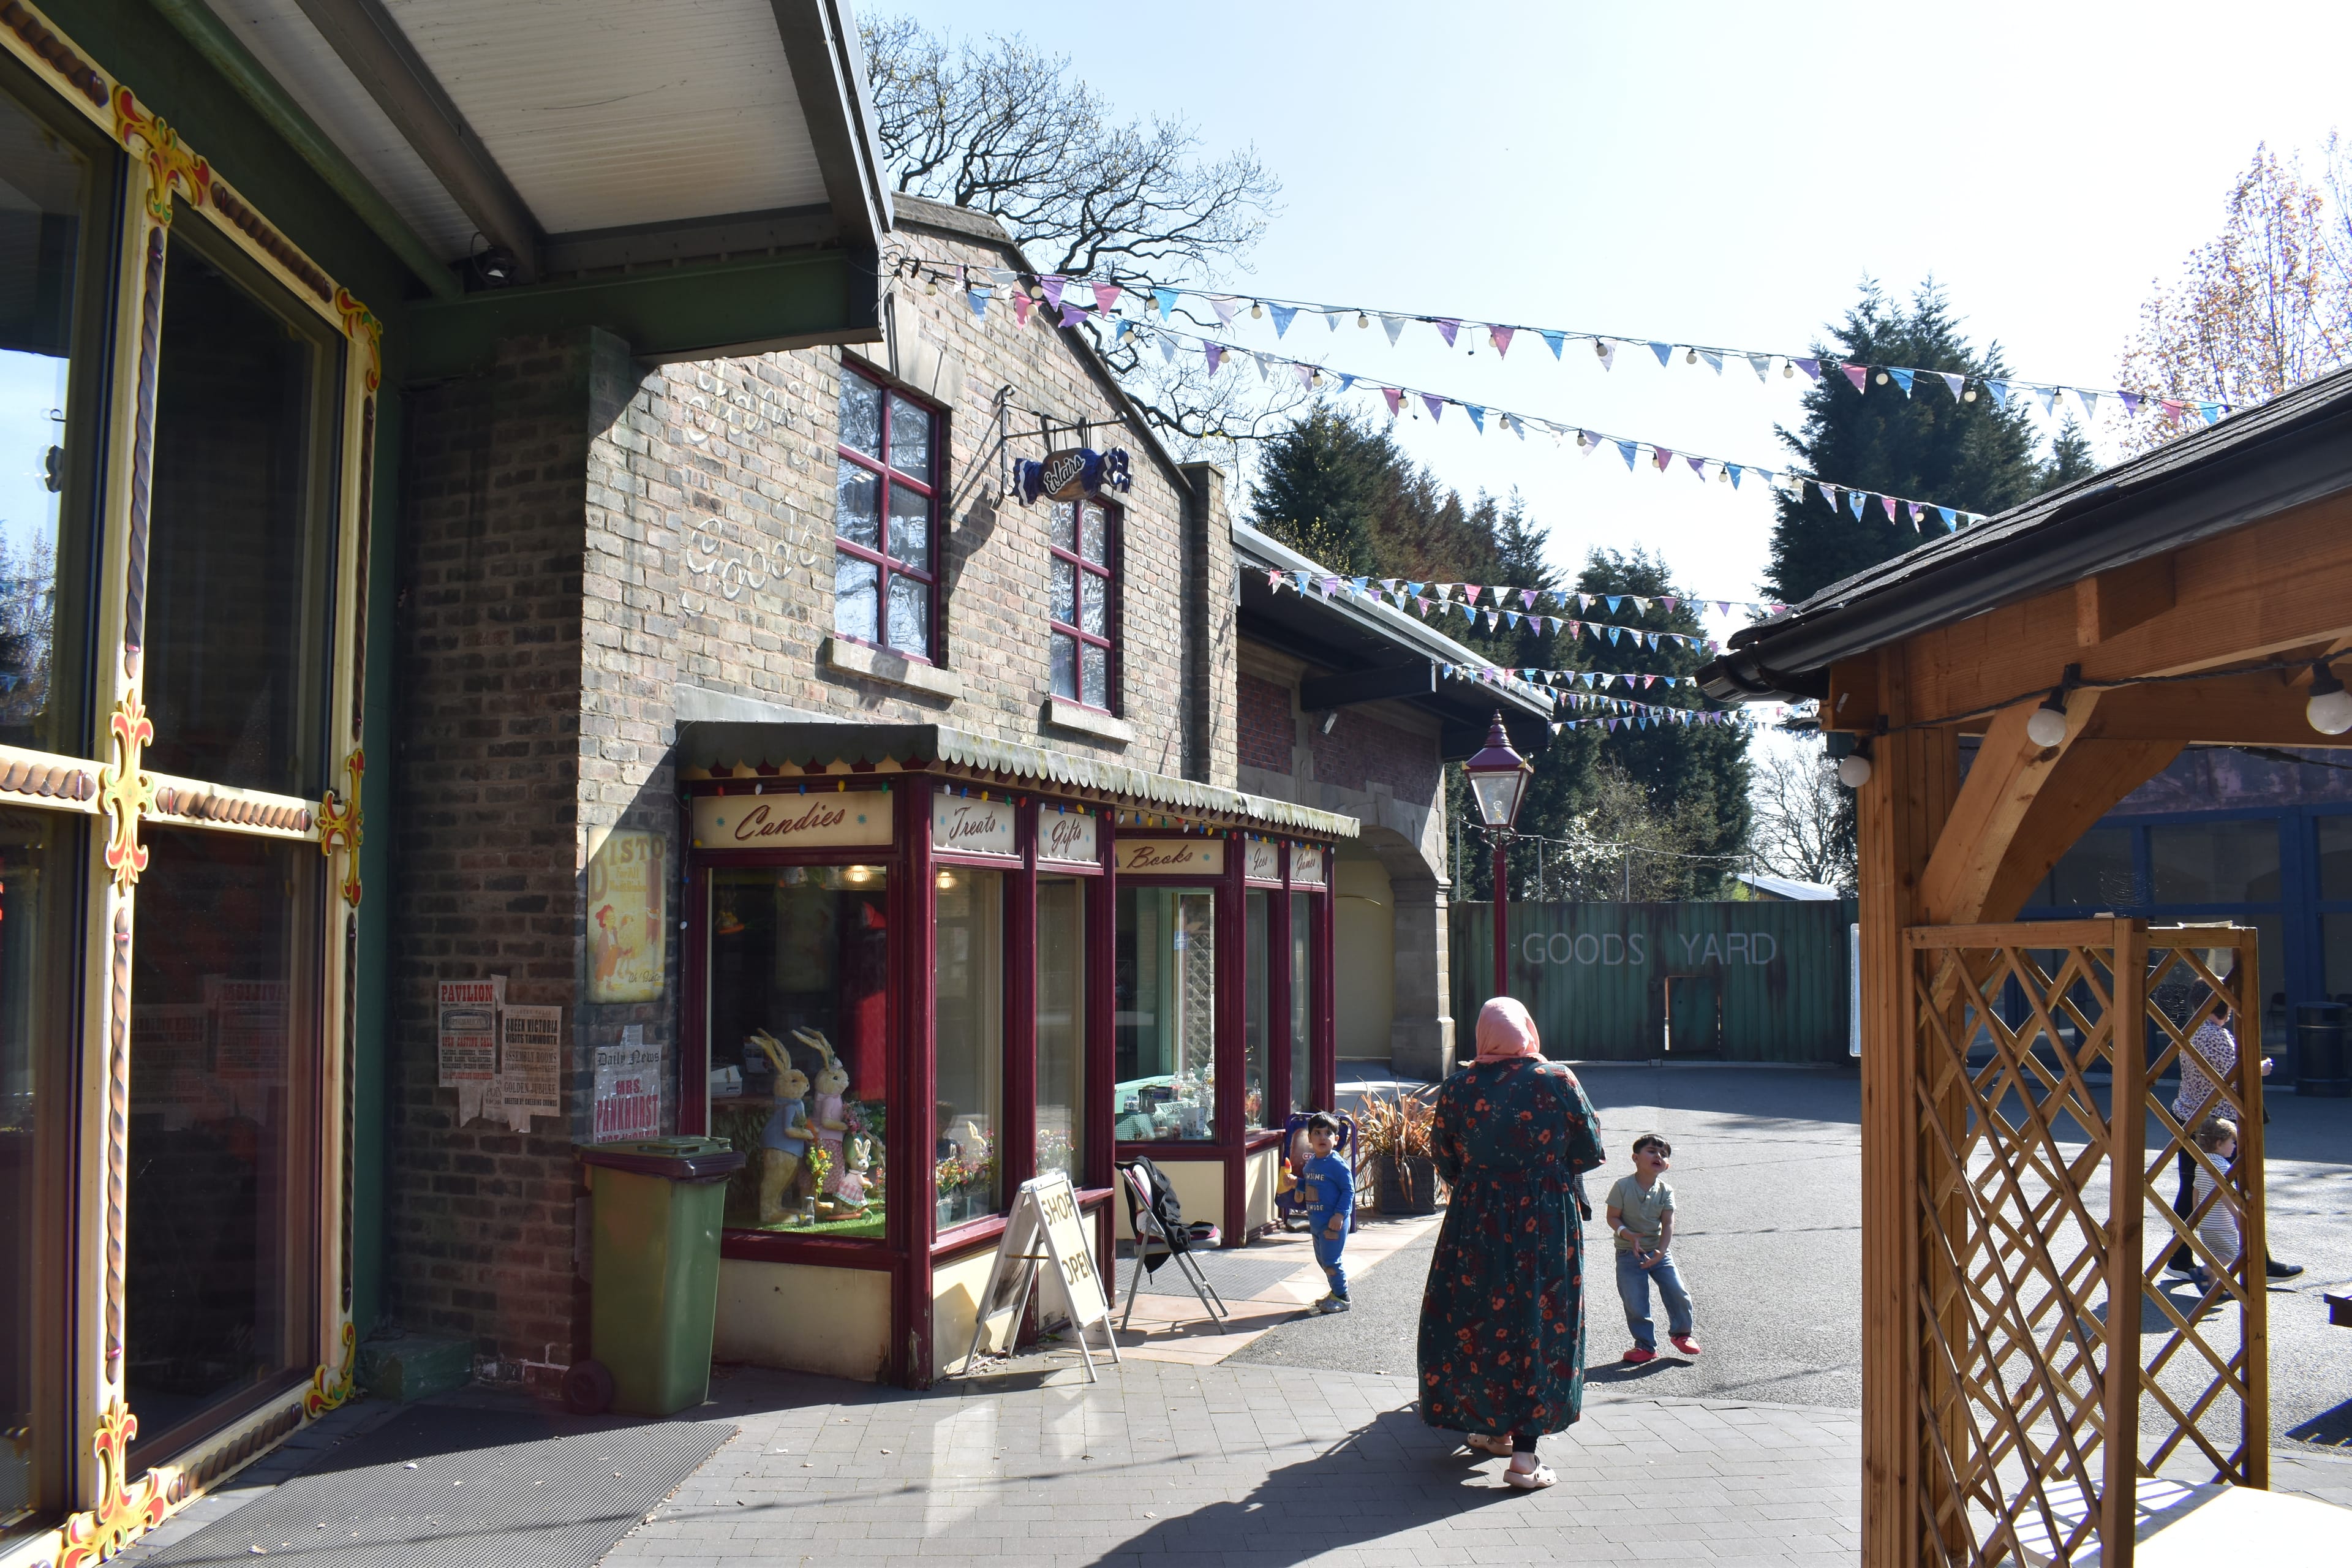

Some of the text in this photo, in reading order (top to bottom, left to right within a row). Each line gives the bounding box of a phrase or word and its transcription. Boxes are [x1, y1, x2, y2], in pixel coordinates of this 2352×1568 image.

[1044, 454, 1085, 494] Eclairs
[681, 496, 820, 616] Goods
[734, 801, 845, 841] Candies
[949, 806, 997, 840] Treats
[1052, 820, 1082, 854] Gifts
[588, 837, 665, 903] BISTO
[1126, 845, 1193, 869] Books
[1295, 853, 1316, 877] Games
[1522, 932, 1777, 965] GOODS YARD
[441, 984, 494, 1003] PAVILION
[505, 1018, 558, 1033] QUEEN VICTORIA
[505, 1033, 524, 1044] VISITS
[524, 1034, 557, 1045] TAMWORTH
[442, 1036, 493, 1047] OPEN CASTING CALL
[505, 1050, 535, 1063] ASSEMBLY
[536, 1051, 557, 1064] ROOMS
[598, 1049, 660, 1067] Daily News
[504, 1082, 529, 1093] GOLDEN
[530, 1082, 557, 1095] JUBILEE
[616, 1079, 643, 1095] MRS.
[597, 1094, 658, 1133] PANKHURST
[1041, 1191, 1072, 1226] SHOP
[1061, 1250, 1095, 1286] OPEN
